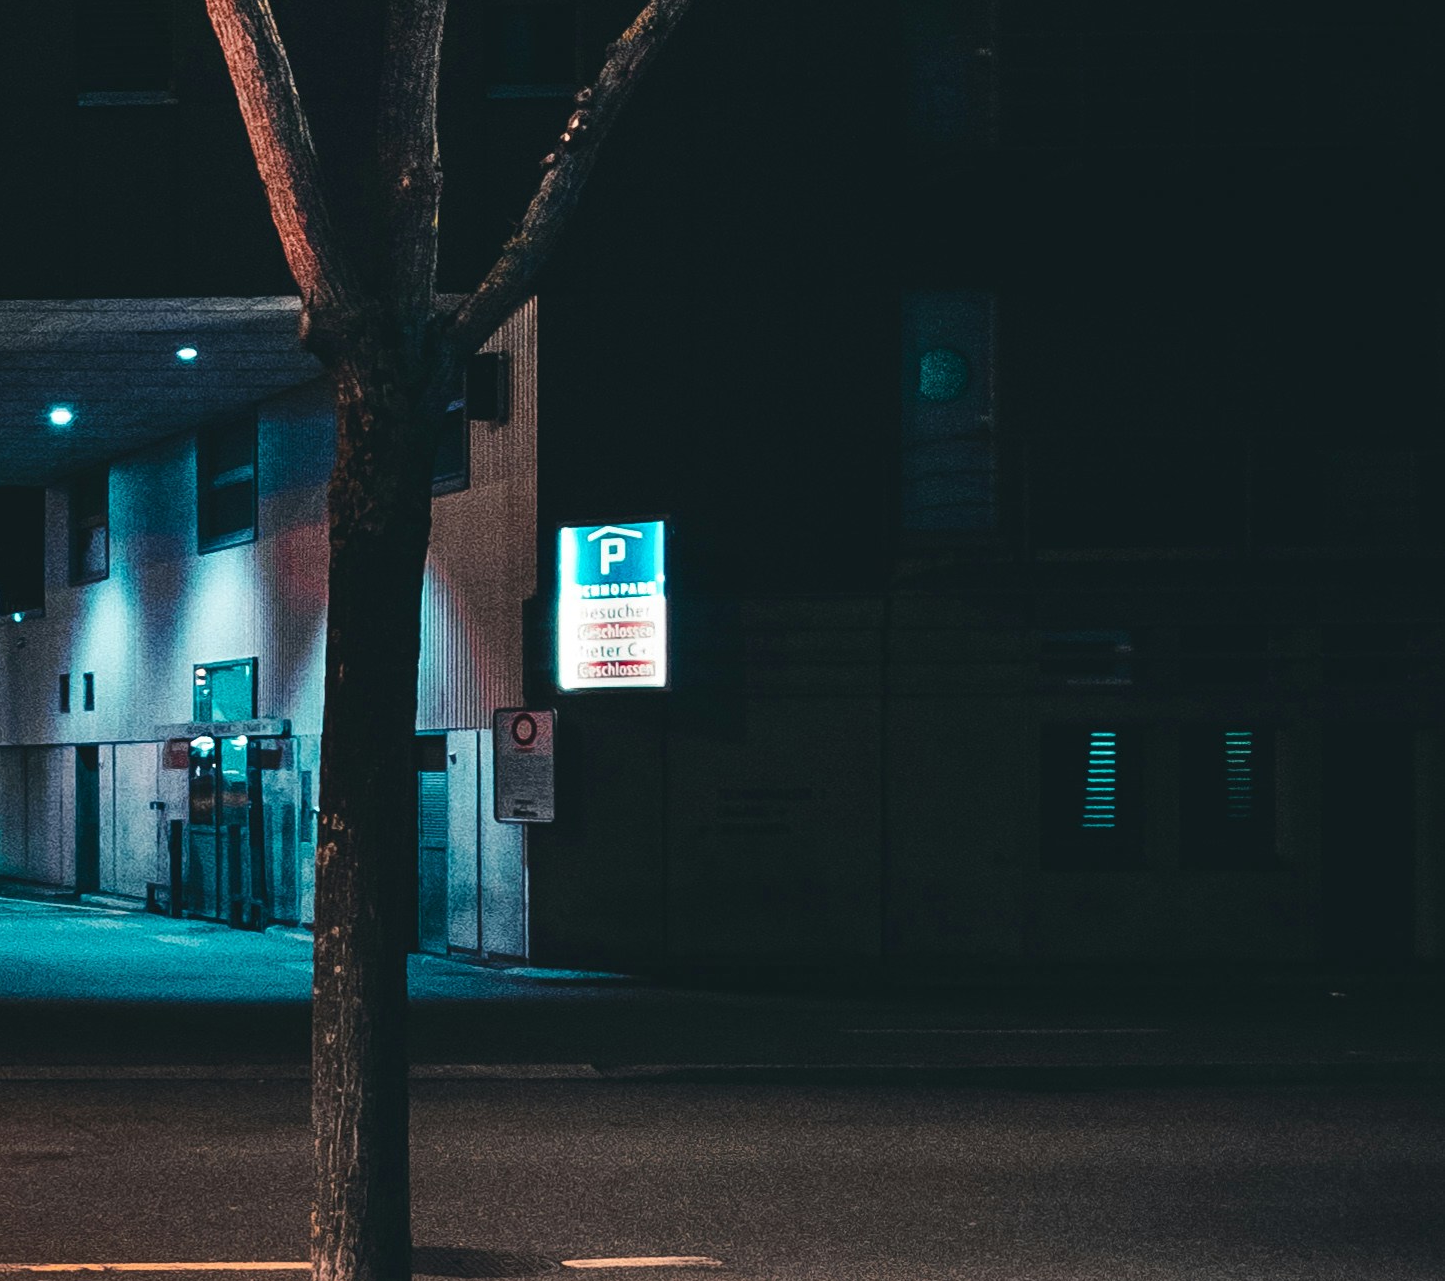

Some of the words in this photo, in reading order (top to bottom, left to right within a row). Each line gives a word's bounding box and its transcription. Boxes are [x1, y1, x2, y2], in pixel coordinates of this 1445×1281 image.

[600, 537, 626, 576] P
[576, 644, 621, 660] ieter
[579, 662, 653, 679] Geschlossen
